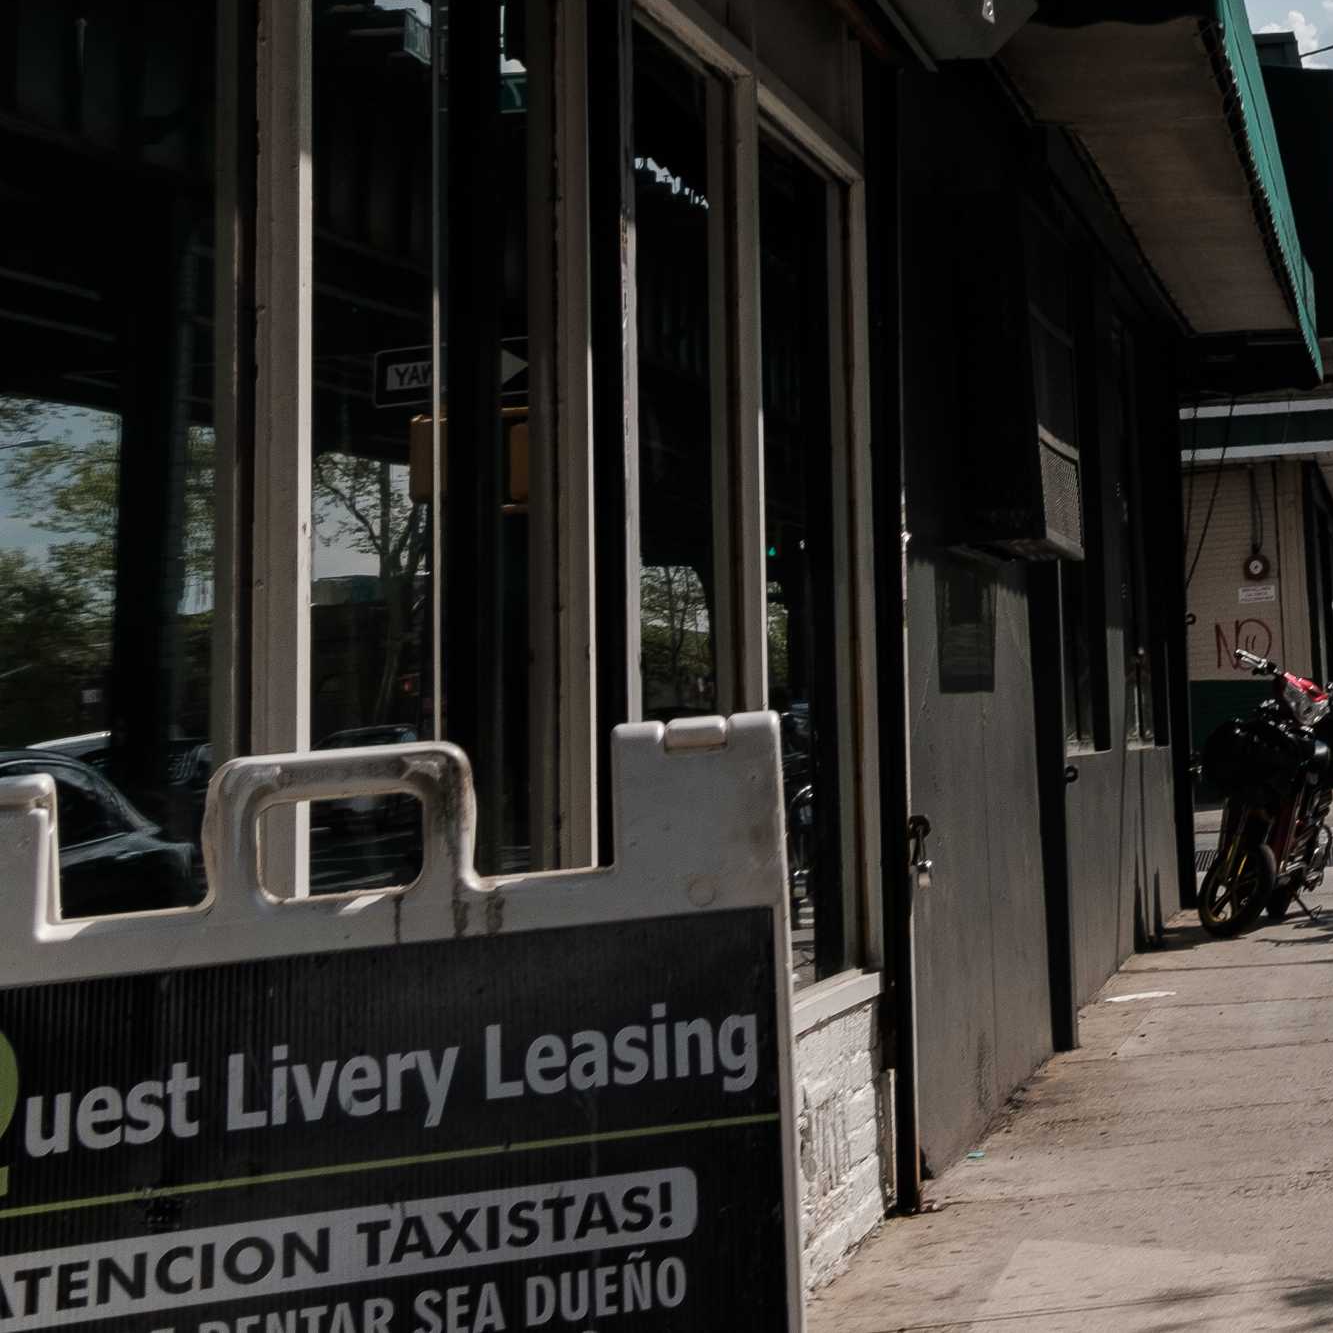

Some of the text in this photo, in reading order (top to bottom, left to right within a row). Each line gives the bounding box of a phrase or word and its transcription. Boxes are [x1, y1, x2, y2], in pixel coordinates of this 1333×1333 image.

[226, 1044, 460, 1132] Livery
[484, 1002, 758, 1100] Leasing
[357, 1182, 673, 1266] TAXISTAS!
[414, 1281, 506, 1333] SEA
[525, 1250, 687, 1328] DUEÑO
